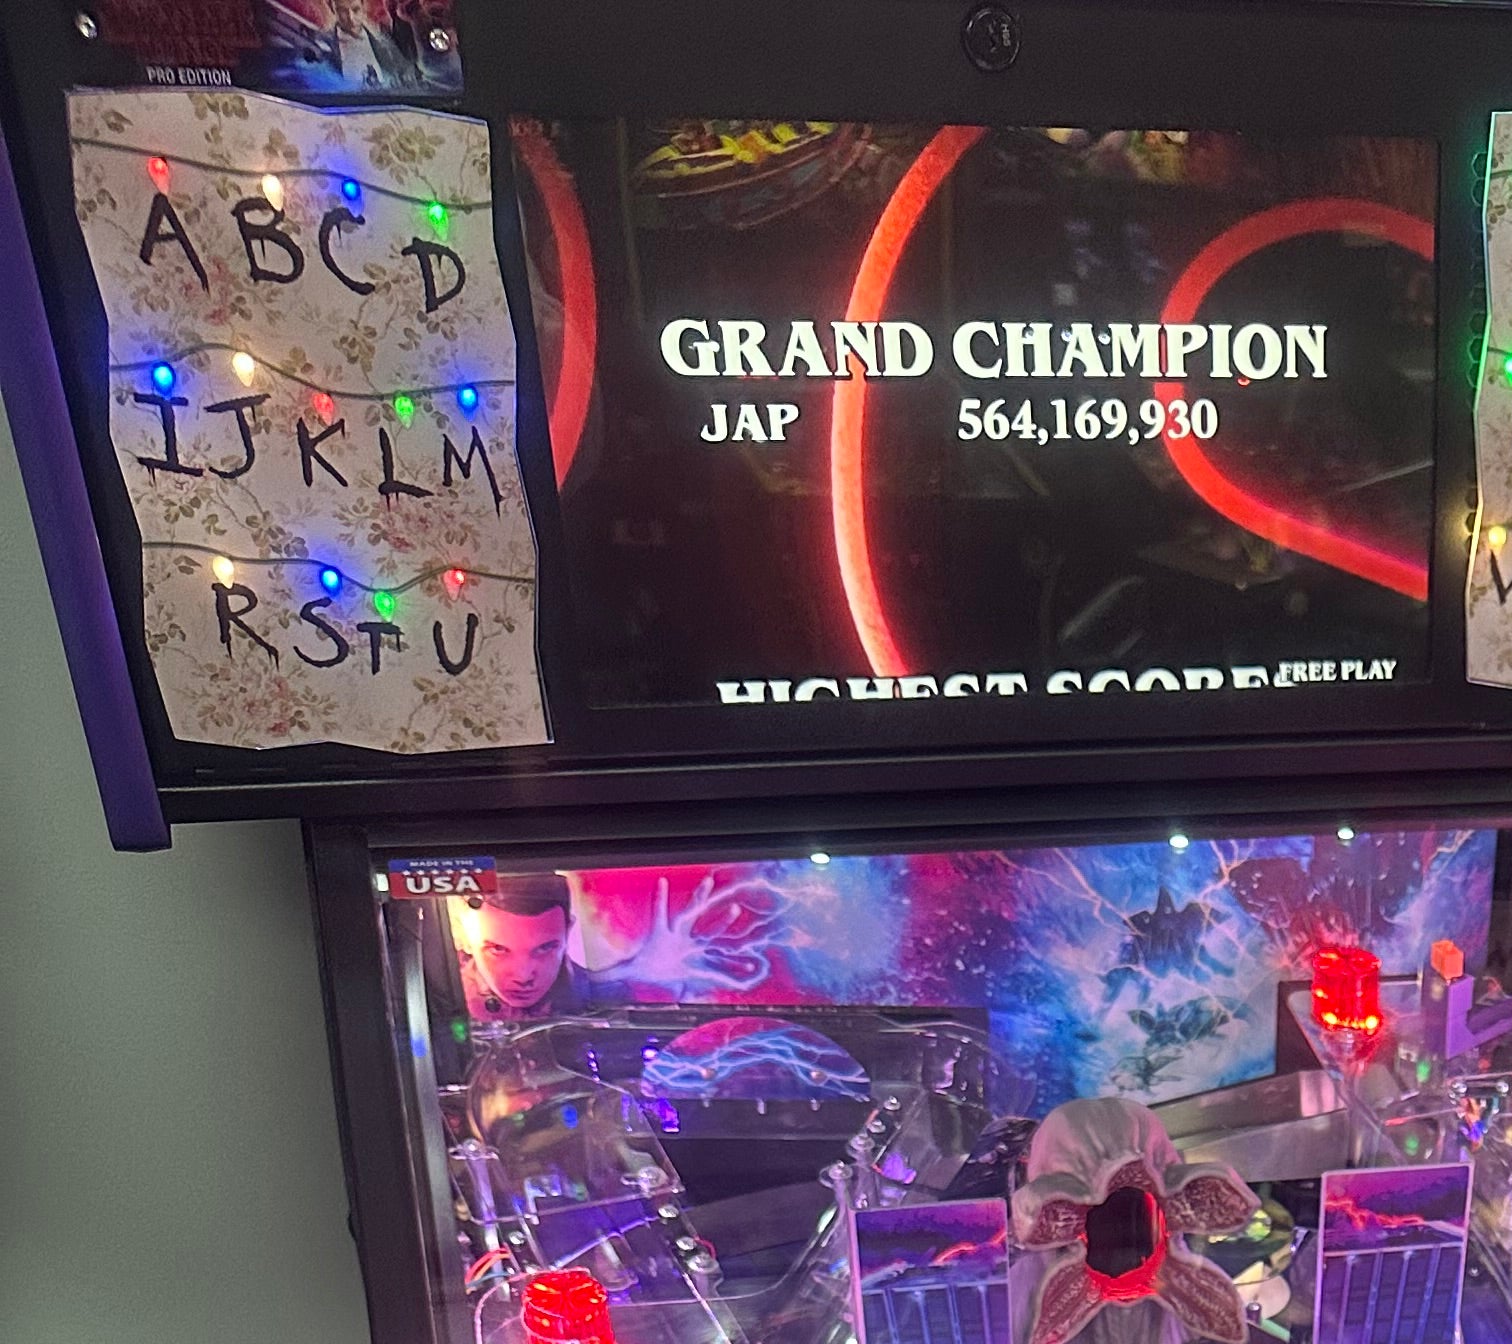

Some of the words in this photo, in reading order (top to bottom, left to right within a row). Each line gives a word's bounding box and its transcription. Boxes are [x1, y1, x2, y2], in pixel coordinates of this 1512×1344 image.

[147, 66, 174, 84] PRO
[178, 66, 232, 86] EDITION
[658, 317, 934, 382] GRAND
[951, 319, 1328, 381] CHAMPION
[700, 402, 800, 444] JAP
[956, 397, 1219, 444] 564,169,930
[1278, 661, 1336, 684] FREE
[1340, 659, 1398, 681] PLAY
[406, 875, 480, 894] USA
